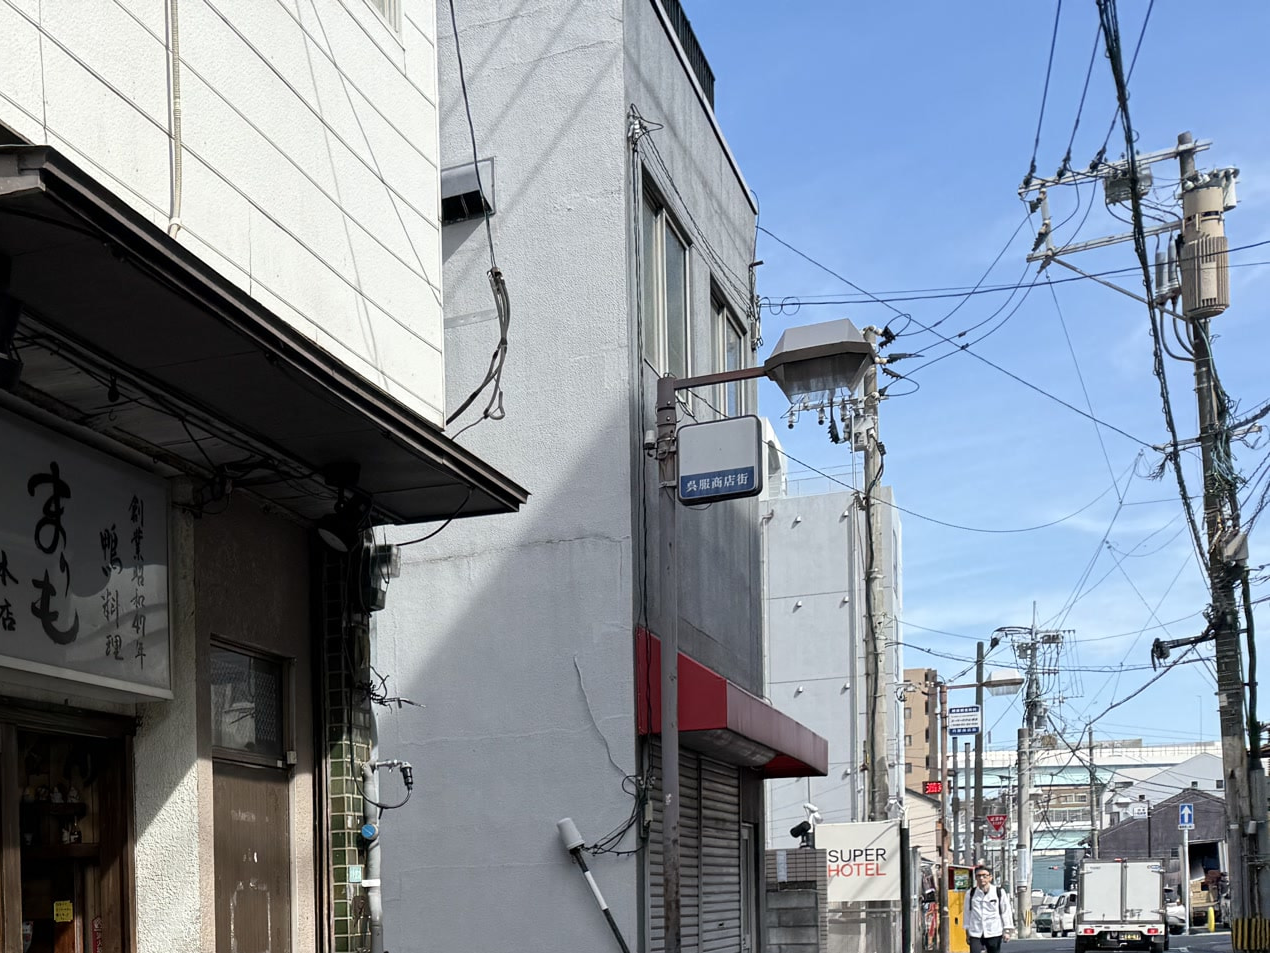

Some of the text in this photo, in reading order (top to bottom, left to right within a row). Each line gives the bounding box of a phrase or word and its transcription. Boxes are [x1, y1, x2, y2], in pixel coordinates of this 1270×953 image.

[686, 473, 748, 492] 呉服商店街
[99, 523, 124, 660] 鴨料理
[129, 495, 146, 670] 創業昭和47年
[828, 848, 887, 863] SUPER
[828, 862, 887, 877] HOTEL
